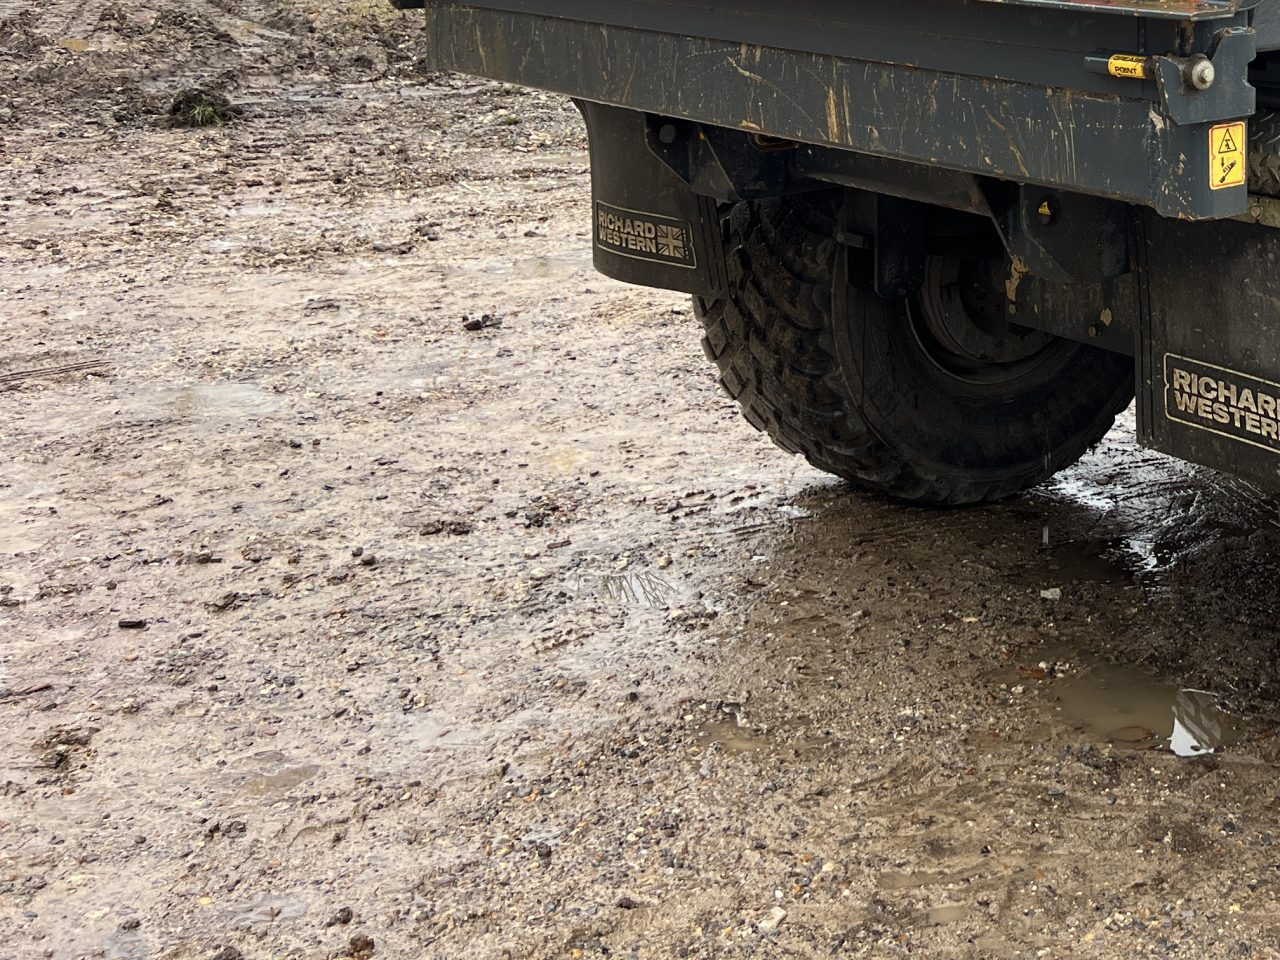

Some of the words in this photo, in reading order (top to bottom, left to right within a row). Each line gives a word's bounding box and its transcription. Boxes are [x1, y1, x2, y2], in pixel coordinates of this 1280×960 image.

[1113, 55, 1146, 63] GREASE
[1114, 66, 1137, 75] POINT
[597, 209, 656, 239] RICHARD
[598, 224, 657, 254] WESTERN
